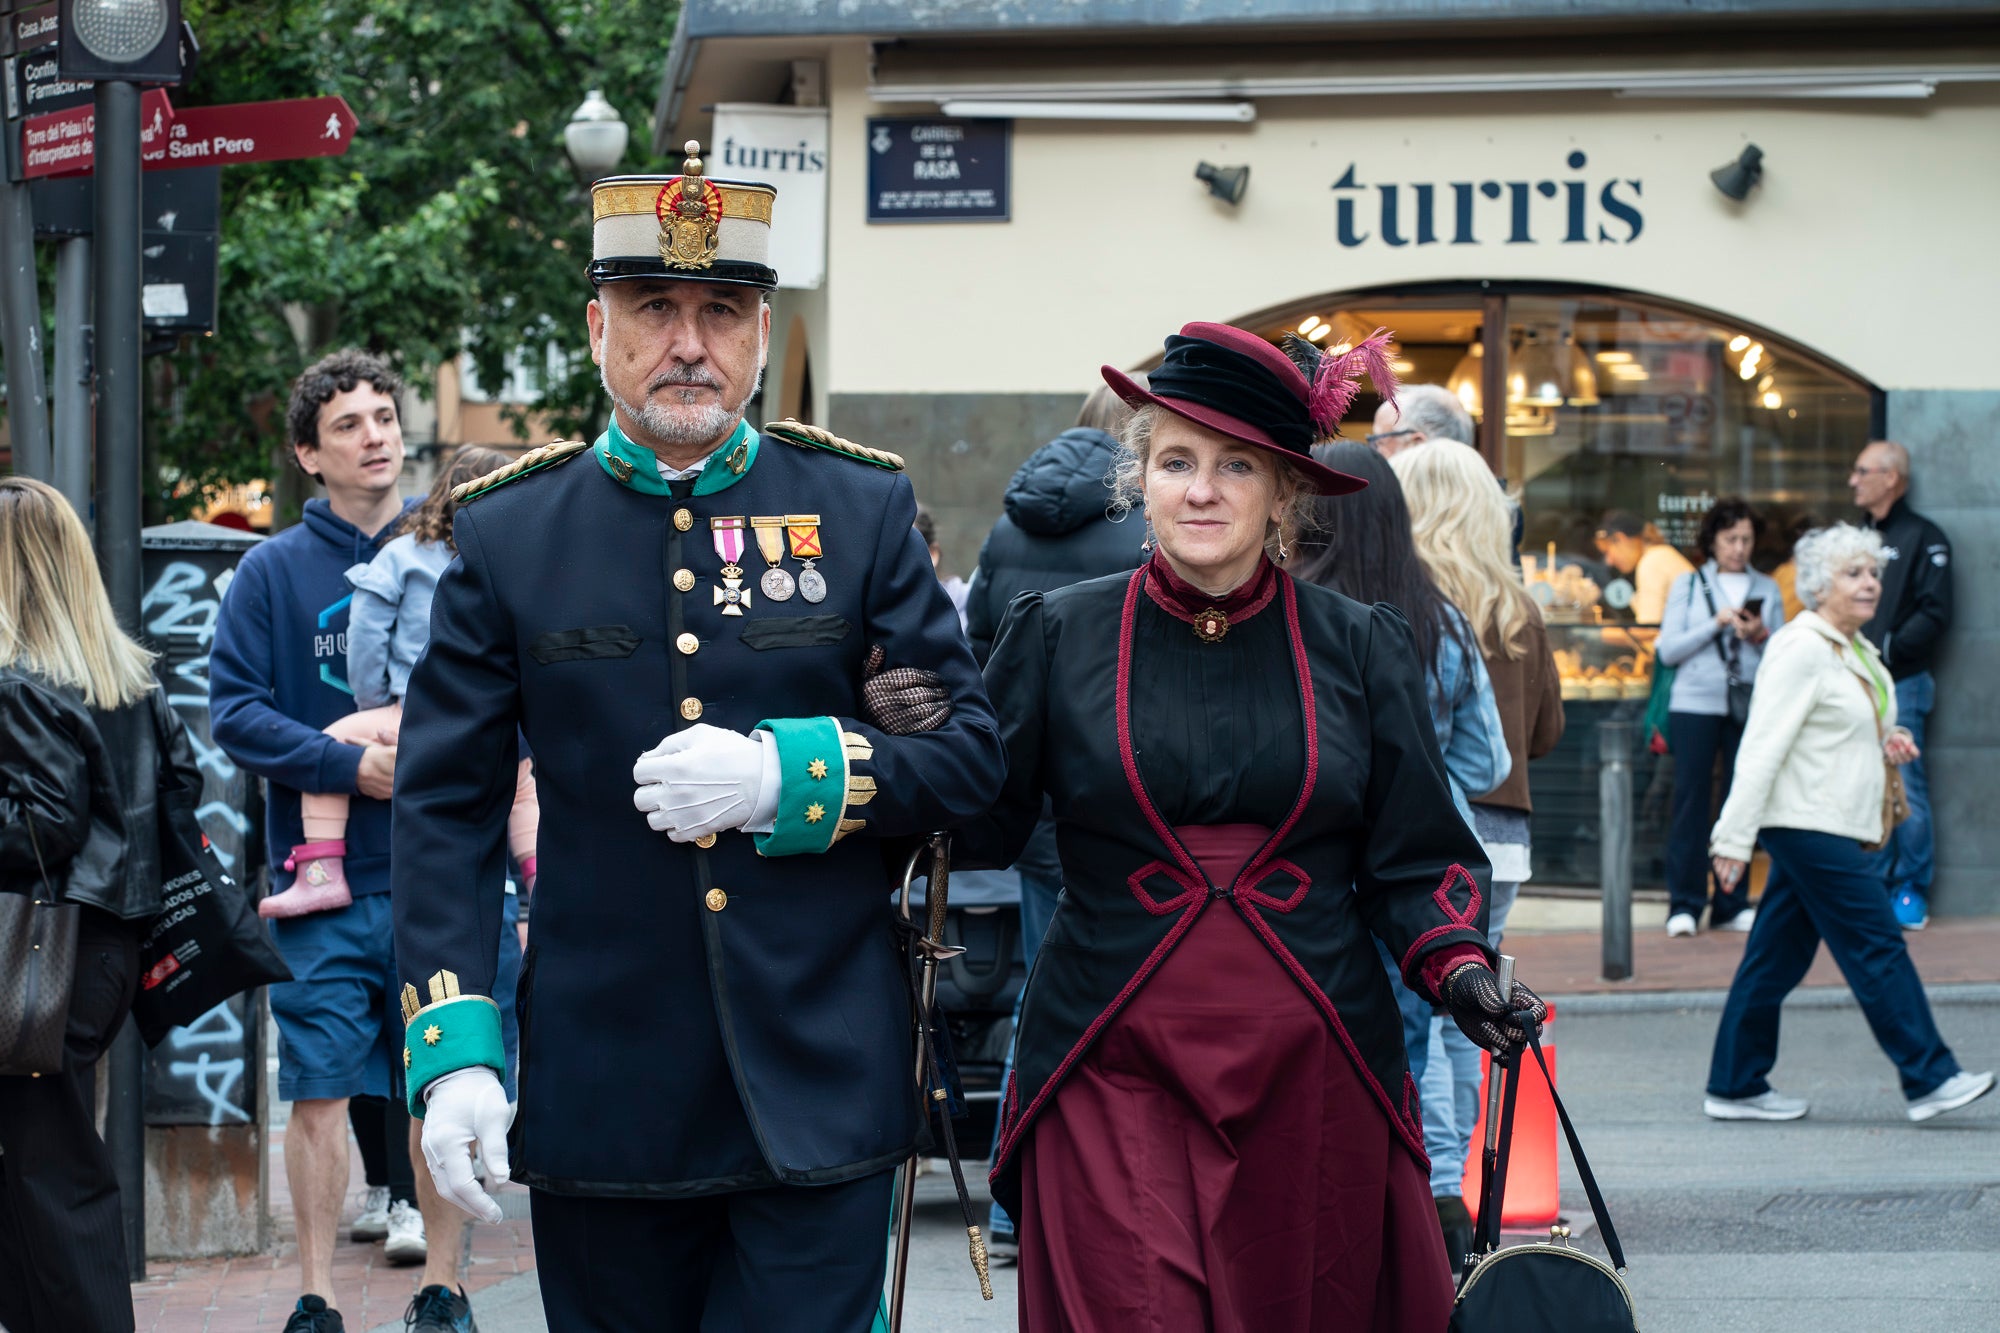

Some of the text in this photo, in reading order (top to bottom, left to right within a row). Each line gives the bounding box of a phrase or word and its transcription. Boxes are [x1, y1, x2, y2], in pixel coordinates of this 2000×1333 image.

[18, 20, 39, 39] Casa
[26, 129, 46, 146] Torre
[47, 124, 60, 142] del
[60, 120, 83, 138] Palau
[28, 139, 81, 167] d'interpretació
[81, 137, 94, 155] de
[168, 139, 211, 159] Sant
[213, 136, 255, 156] Pere
[723, 136, 825, 173] turris
[913, 159, 961, 180] RASA
[1330, 149, 1645, 249] turris
[194, 881, 212, 898] DE
